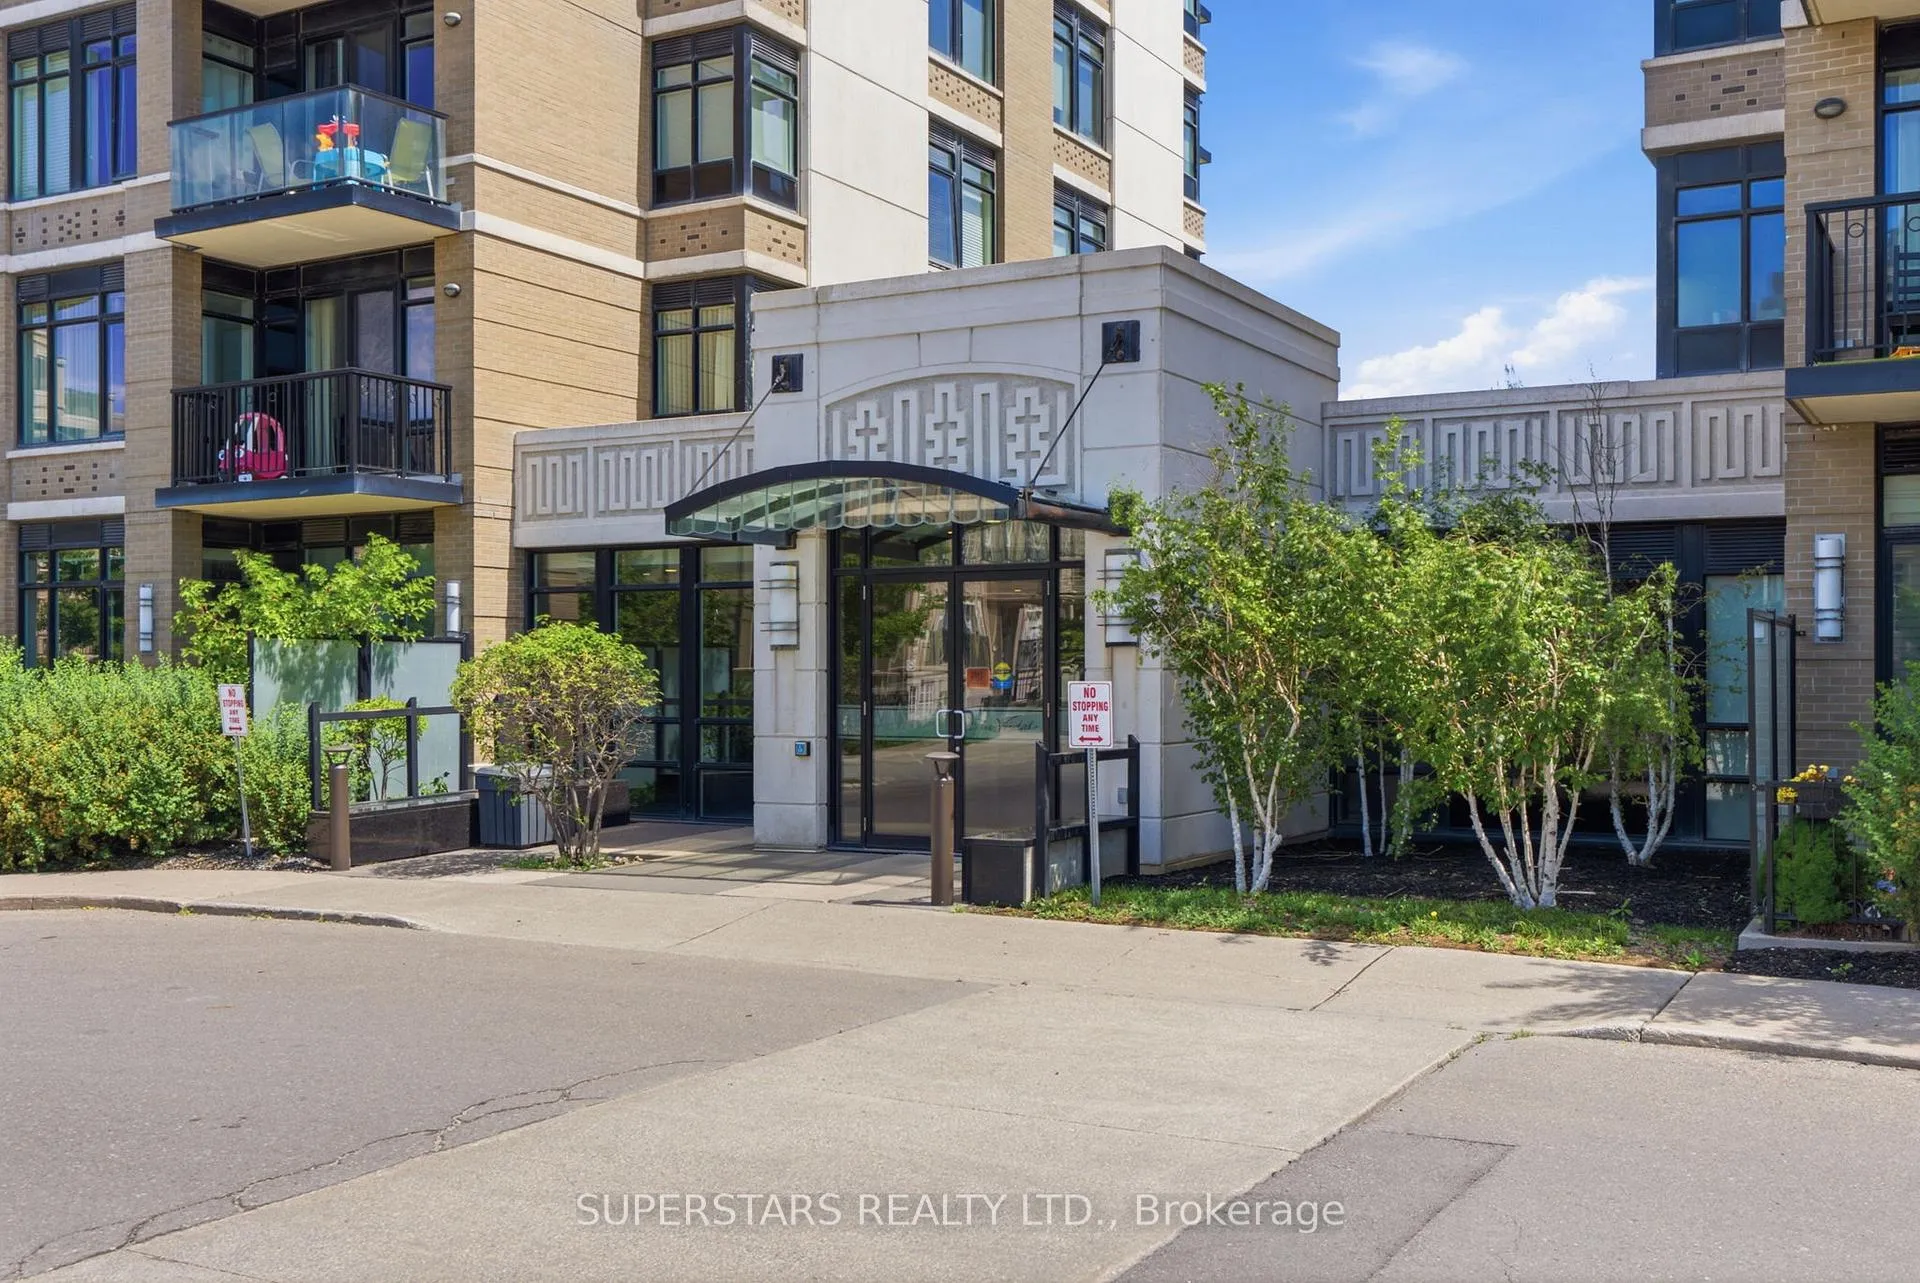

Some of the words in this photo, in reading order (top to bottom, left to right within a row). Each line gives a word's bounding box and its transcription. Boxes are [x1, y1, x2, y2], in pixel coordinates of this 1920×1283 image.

[228, 689, 236, 697] NO
[1083, 687, 1096, 698] NO
[223, 699, 244, 707] STOPPING
[1072, 701, 1109, 711] STOPPING
[1082, 714, 1098, 722] ANY
[1081, 724, 1100, 732] TIME
